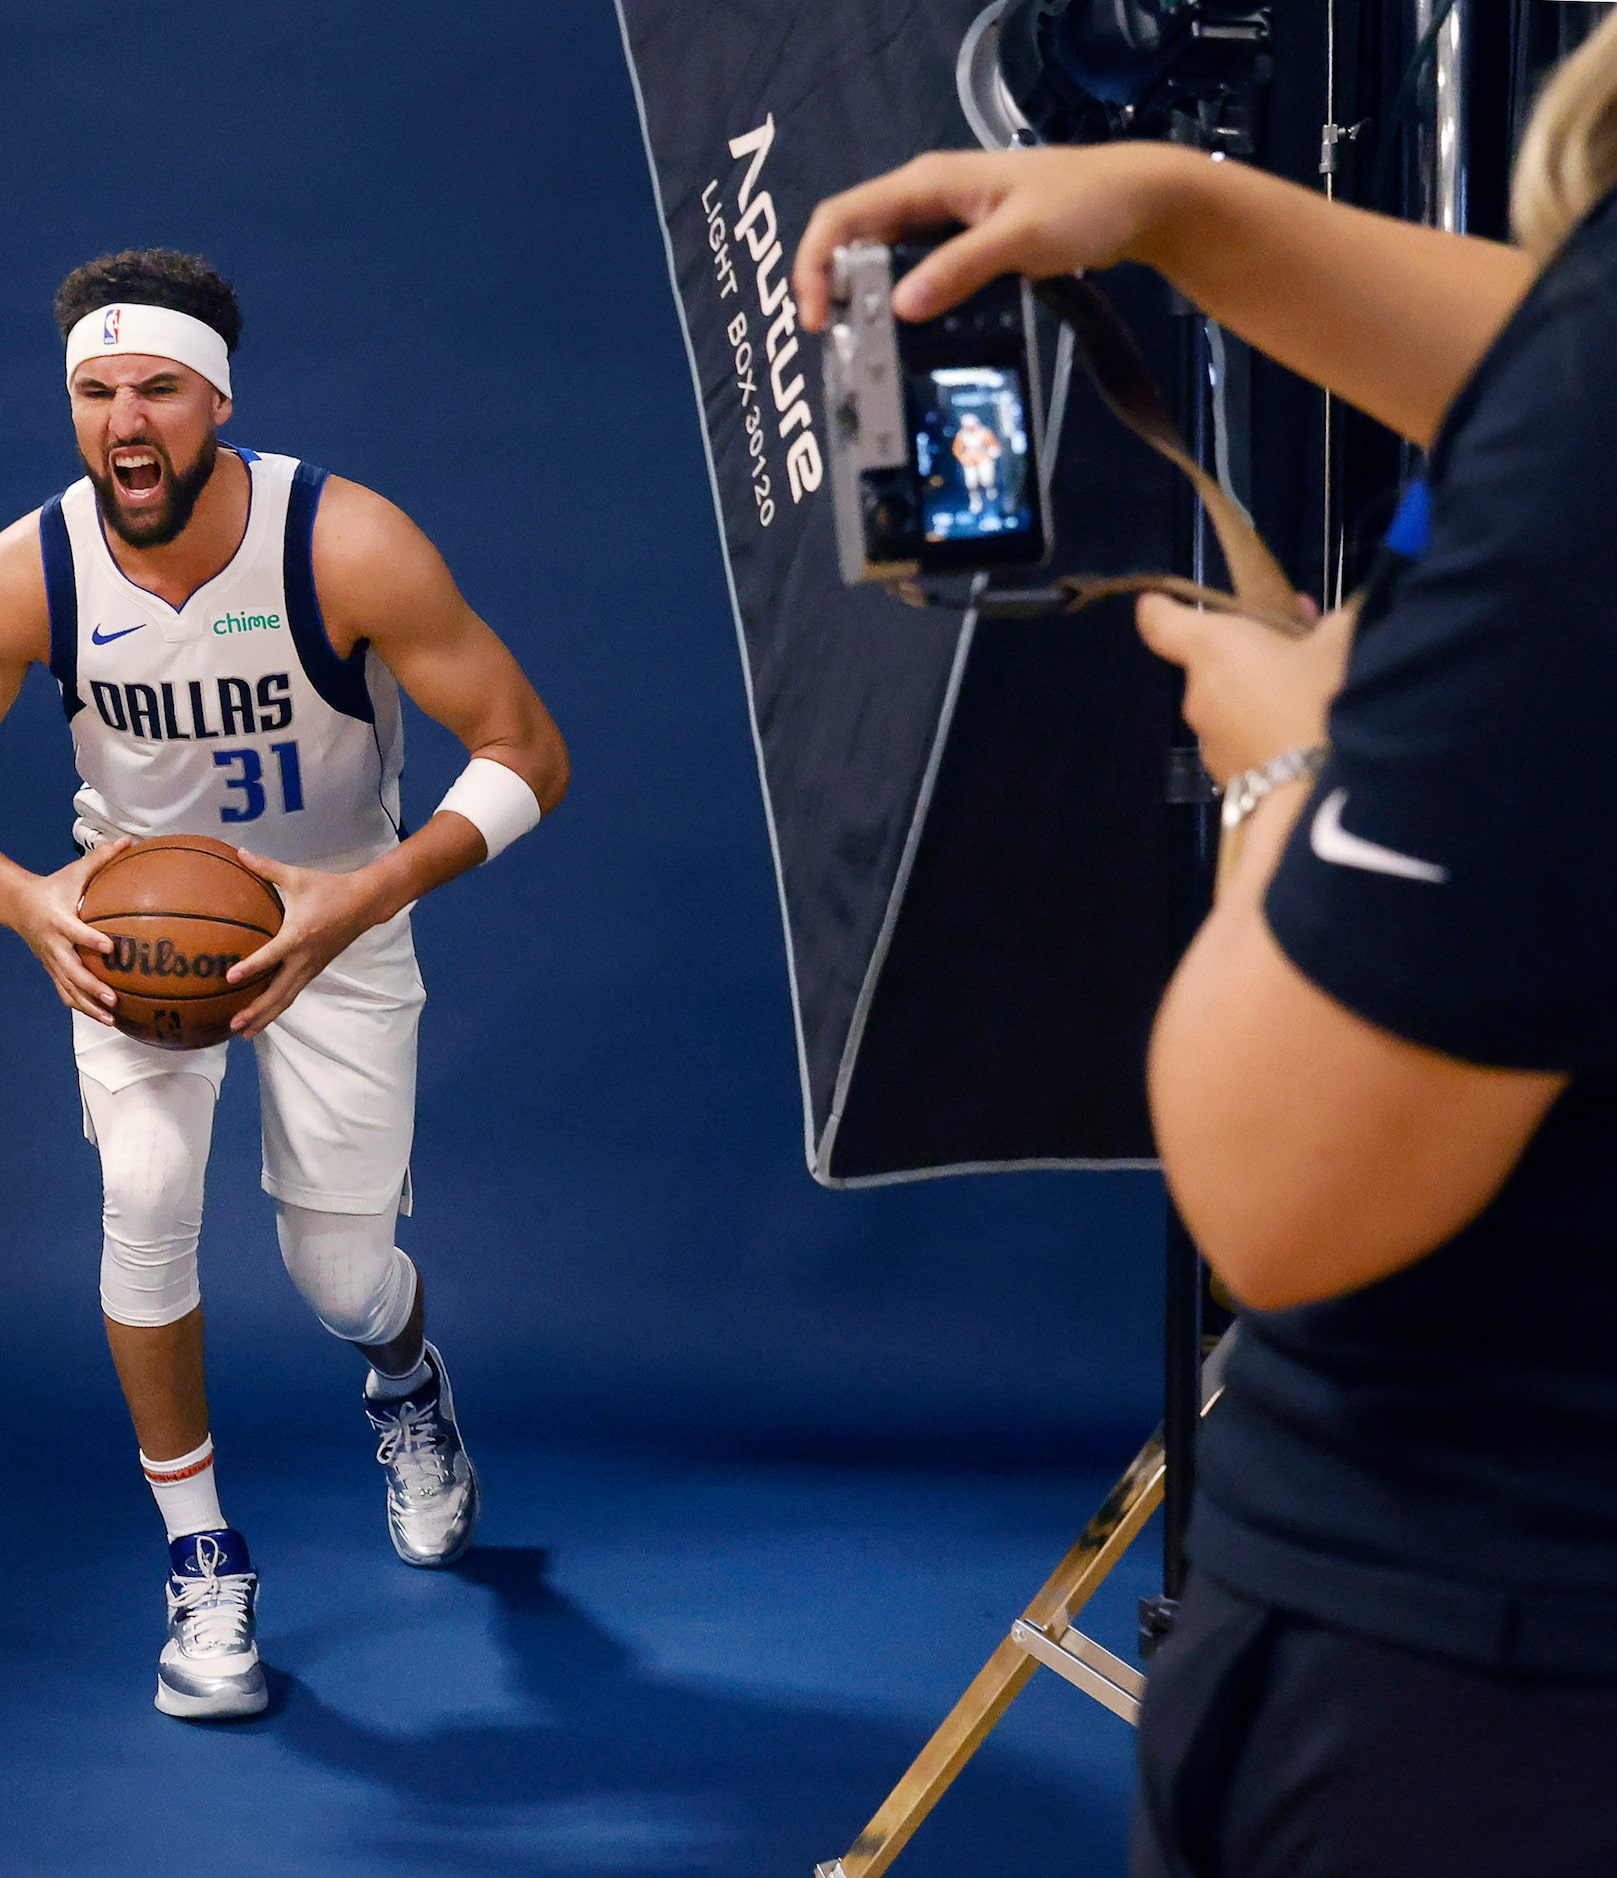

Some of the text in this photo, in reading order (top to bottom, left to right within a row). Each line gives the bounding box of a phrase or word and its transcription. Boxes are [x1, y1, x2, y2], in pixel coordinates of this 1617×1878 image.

[728, 111, 824, 504] Aputure
[700, 178, 776, 528] LIGHT BOX 30120
[212, 611, 282, 635] chime
[89, 672, 294, 742] DALLAS
[213, 740, 306, 824] 31
